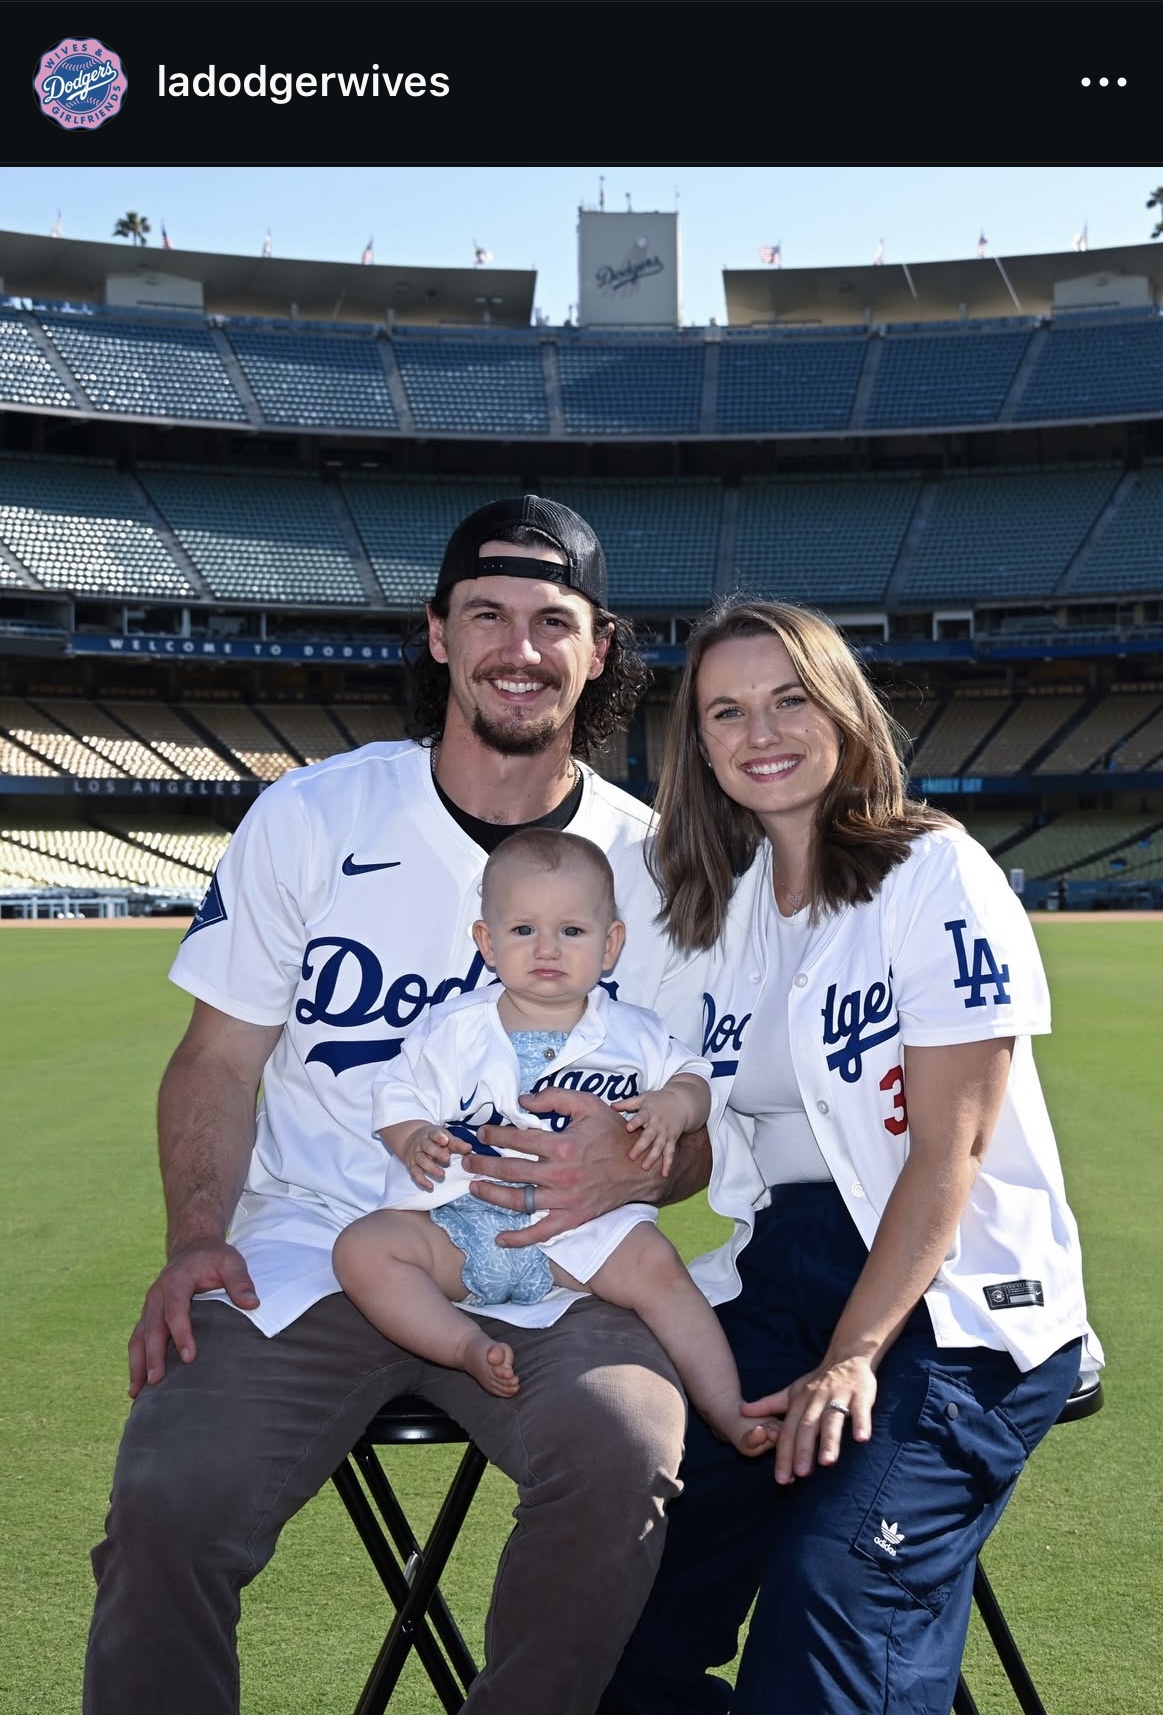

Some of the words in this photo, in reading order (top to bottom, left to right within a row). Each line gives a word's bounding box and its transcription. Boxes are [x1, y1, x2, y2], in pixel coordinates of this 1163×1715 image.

[109, 639, 232, 654] WELCOME
[254, 644, 282, 656] TO
[73, 779, 116, 794] LOS
[132, 779, 241, 795] ANGELES
[944, 919, 1011, 1008] LA
[873, 1536, 897, 1557] adidas
